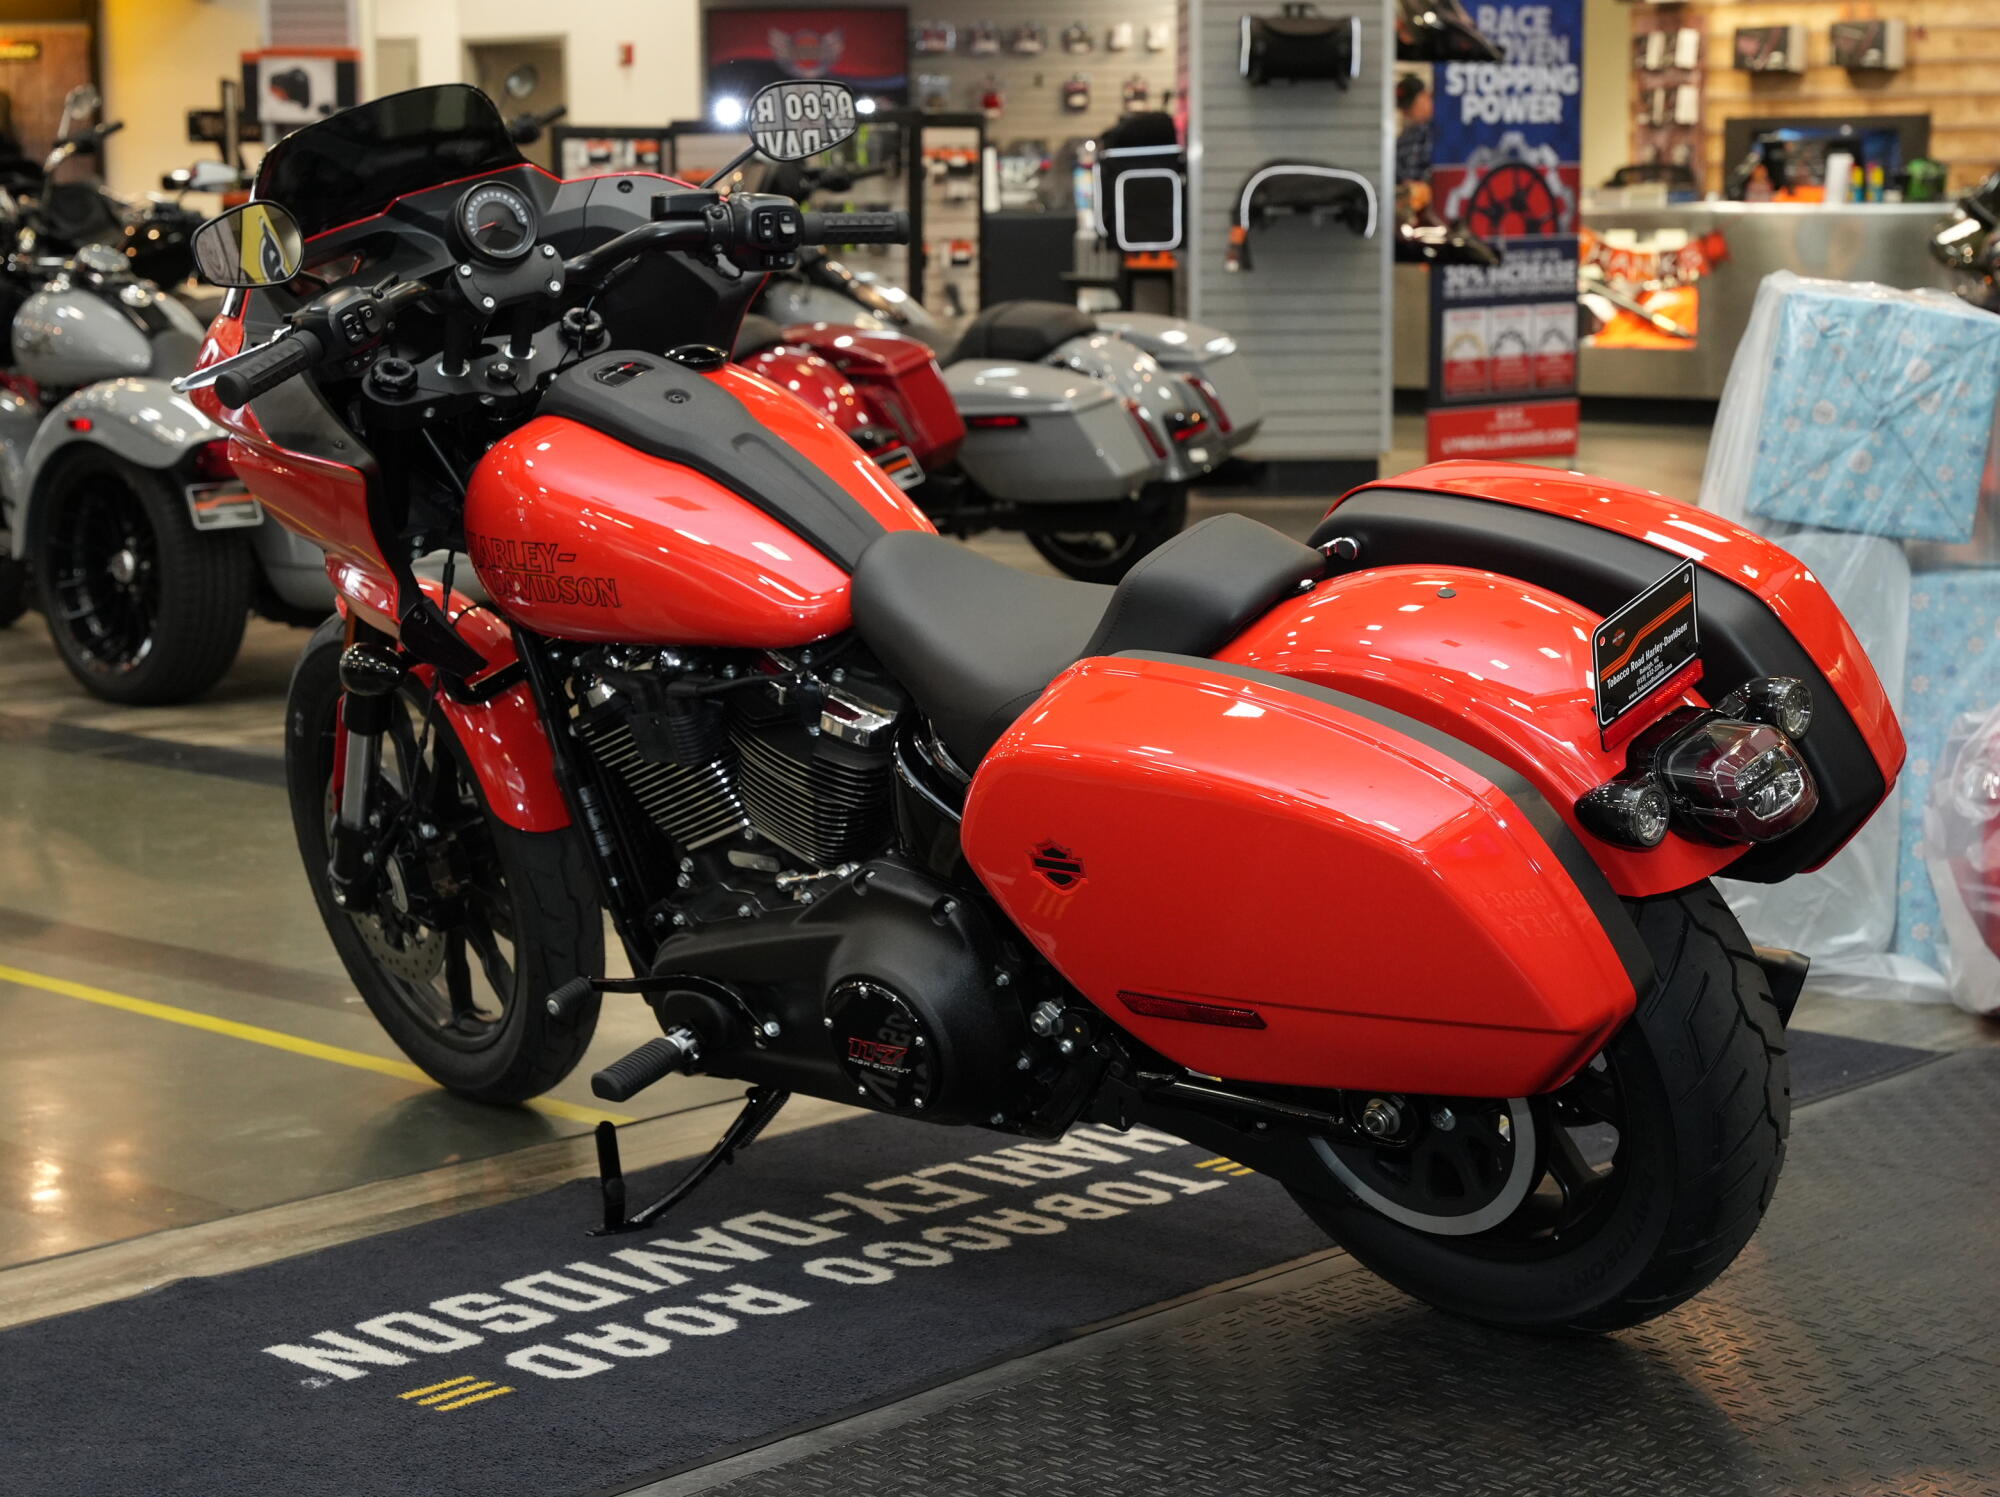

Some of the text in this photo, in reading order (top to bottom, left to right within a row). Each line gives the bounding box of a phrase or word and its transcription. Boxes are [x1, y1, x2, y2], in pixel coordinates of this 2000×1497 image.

[1477, 4, 1551, 36] RACE
[1444, 62, 1579, 96] STOPPING
[1461, 94, 1563, 125] POWER
[1607, 667, 1630, 690] Tobacco
[1630, 653, 1645, 672] Road
[848, 1057, 912, 1074] HIGH OUTPUT
[505, 1170, 1230, 1380] TOBACCO ROAD
